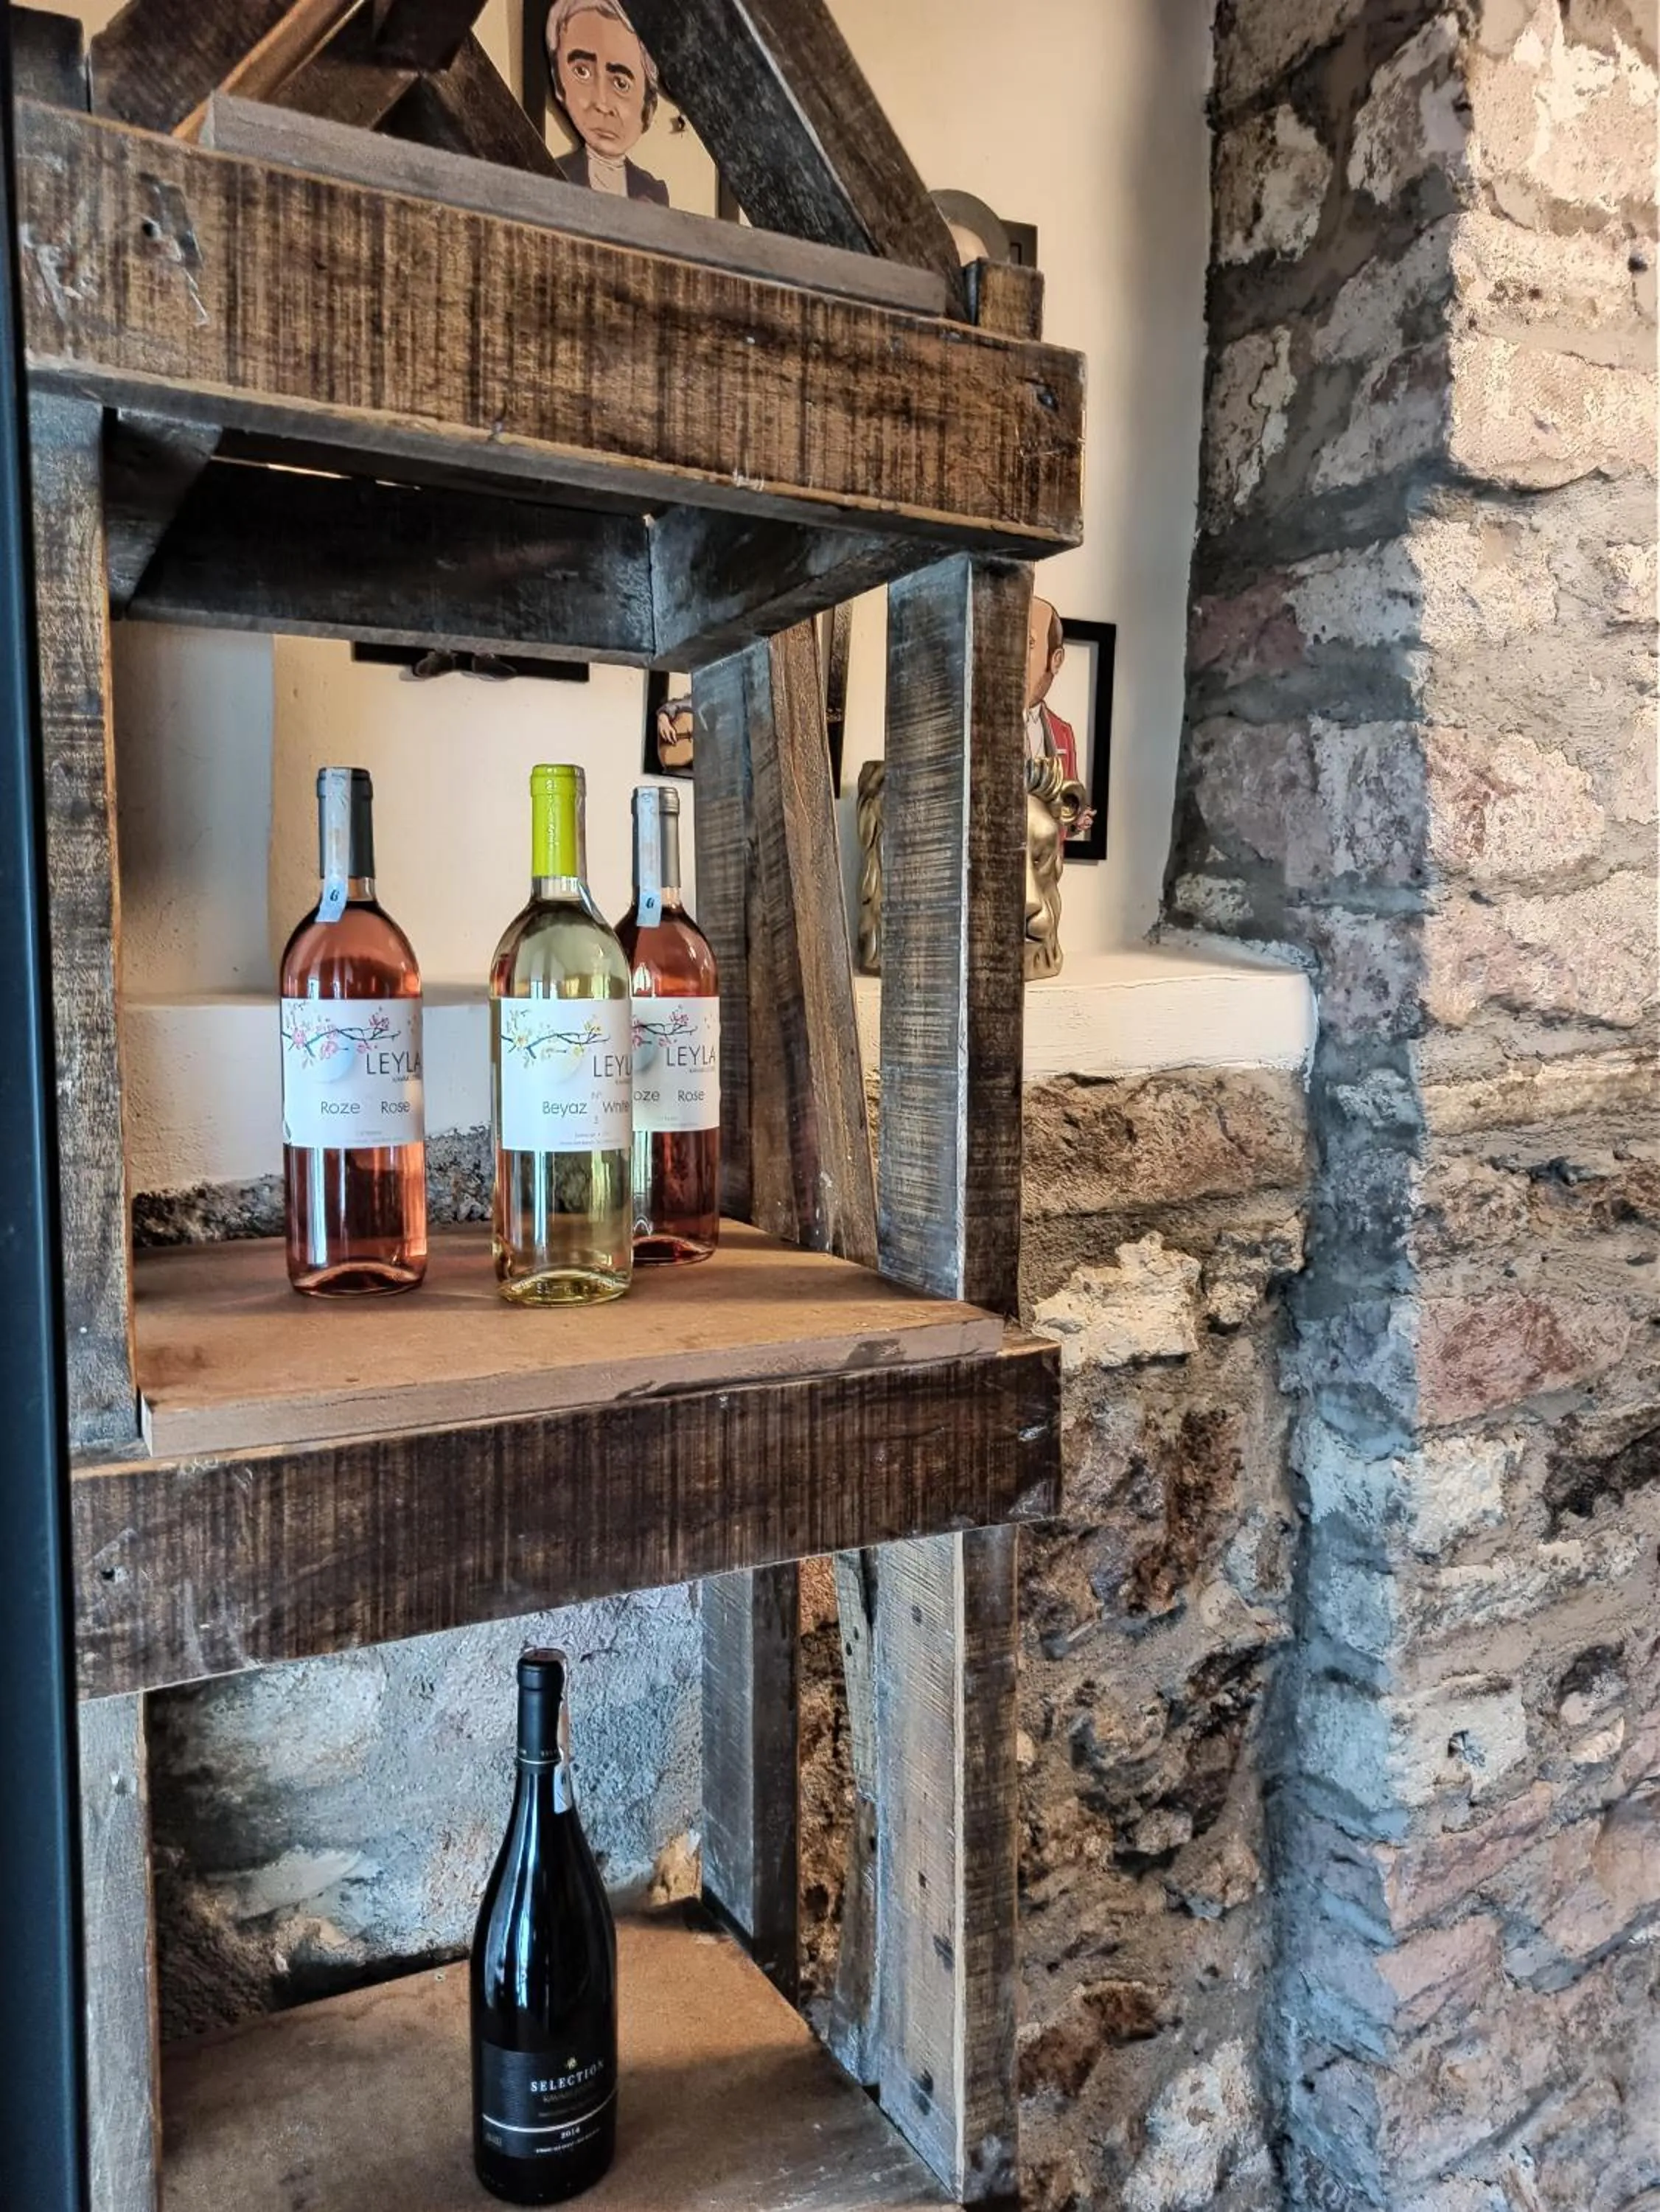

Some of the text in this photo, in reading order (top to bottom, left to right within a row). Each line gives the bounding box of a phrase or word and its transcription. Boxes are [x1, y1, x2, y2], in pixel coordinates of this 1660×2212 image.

[366, 1051, 421, 1074] LEYLA
[666, 1045, 716, 1067] LEYLA
[633, 1090, 660, 1102] oze
[321, 1100, 360, 1114] Roze
[543, 1101, 587, 1119] Beyaz
[530, 2059, 604, 2092] SELECTION
